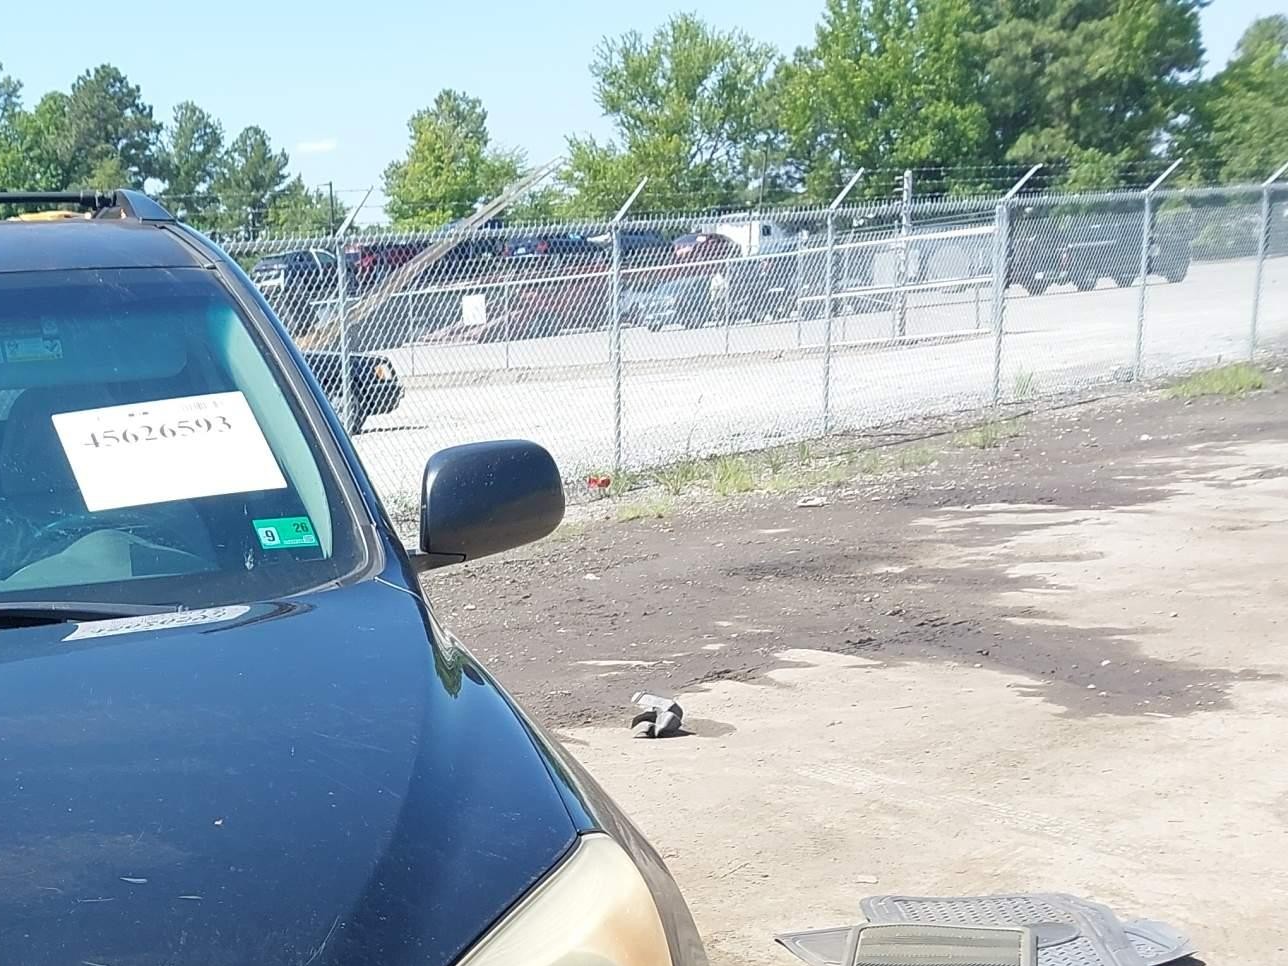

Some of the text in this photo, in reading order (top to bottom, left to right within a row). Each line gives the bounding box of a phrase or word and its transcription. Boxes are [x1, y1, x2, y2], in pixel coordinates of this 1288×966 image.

[82, 415, 232, 448] 45626593
[293, 522, 309, 533] 26
[265, 529, 276, 542] 9
